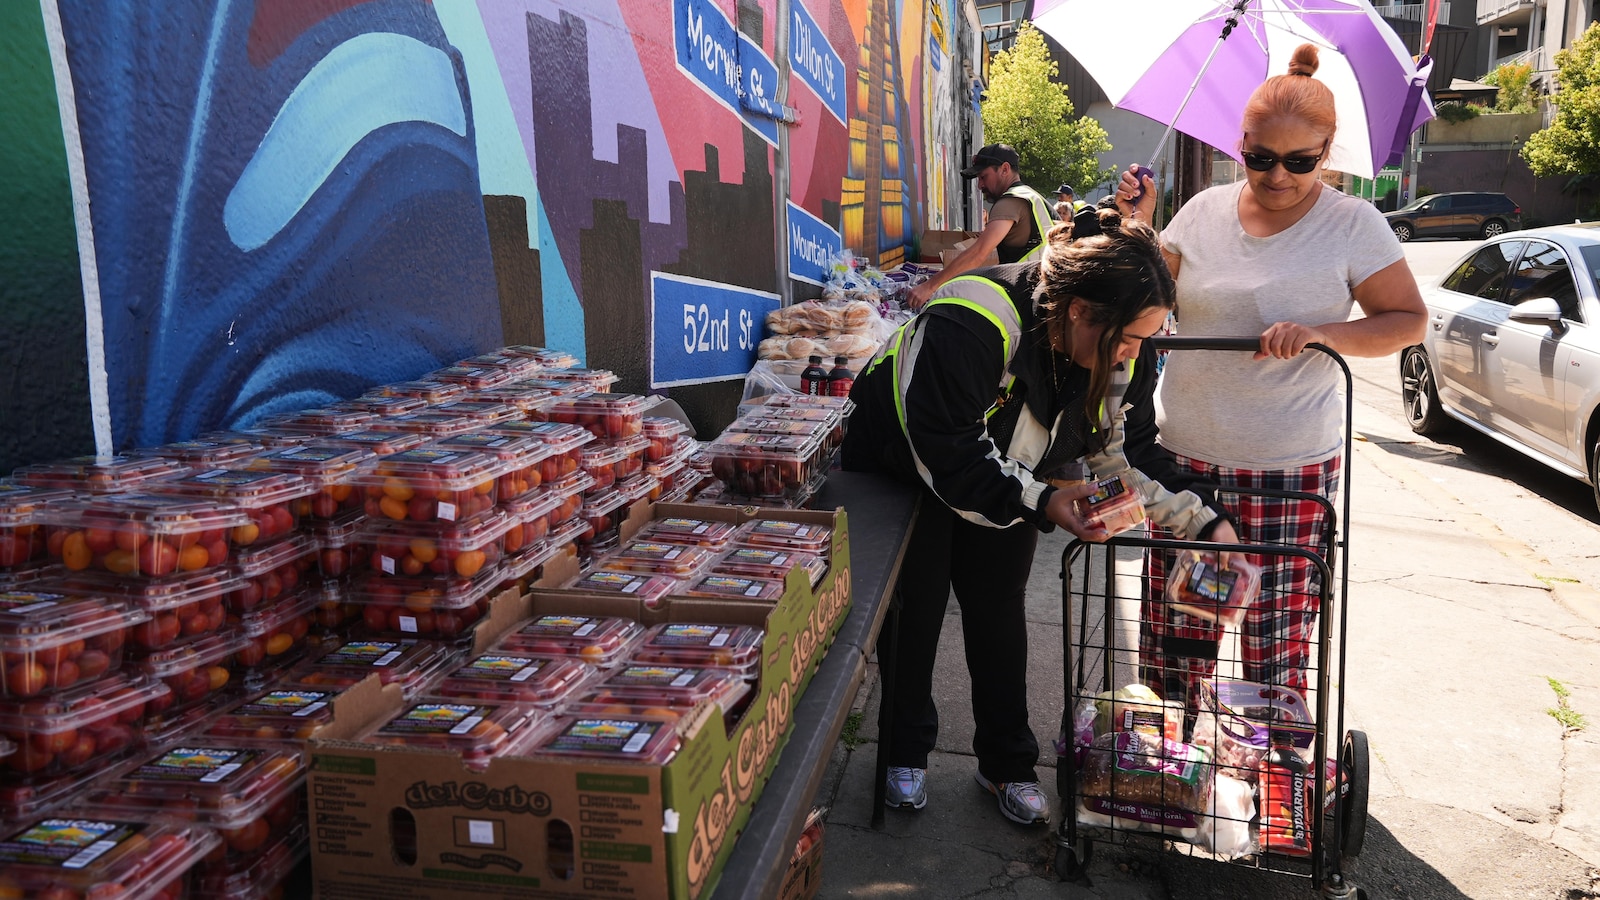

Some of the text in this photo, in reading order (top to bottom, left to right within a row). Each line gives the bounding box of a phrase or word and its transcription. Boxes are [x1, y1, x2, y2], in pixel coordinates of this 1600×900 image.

[794, 11, 836, 101] Dillon St
[792, 222, 826, 269] Mountain
[683, 303, 754, 354] 52nd St
[789, 566, 850, 688] delCabo
[405, 780, 553, 818] delCabo
[686, 681, 790, 898] delCabo
